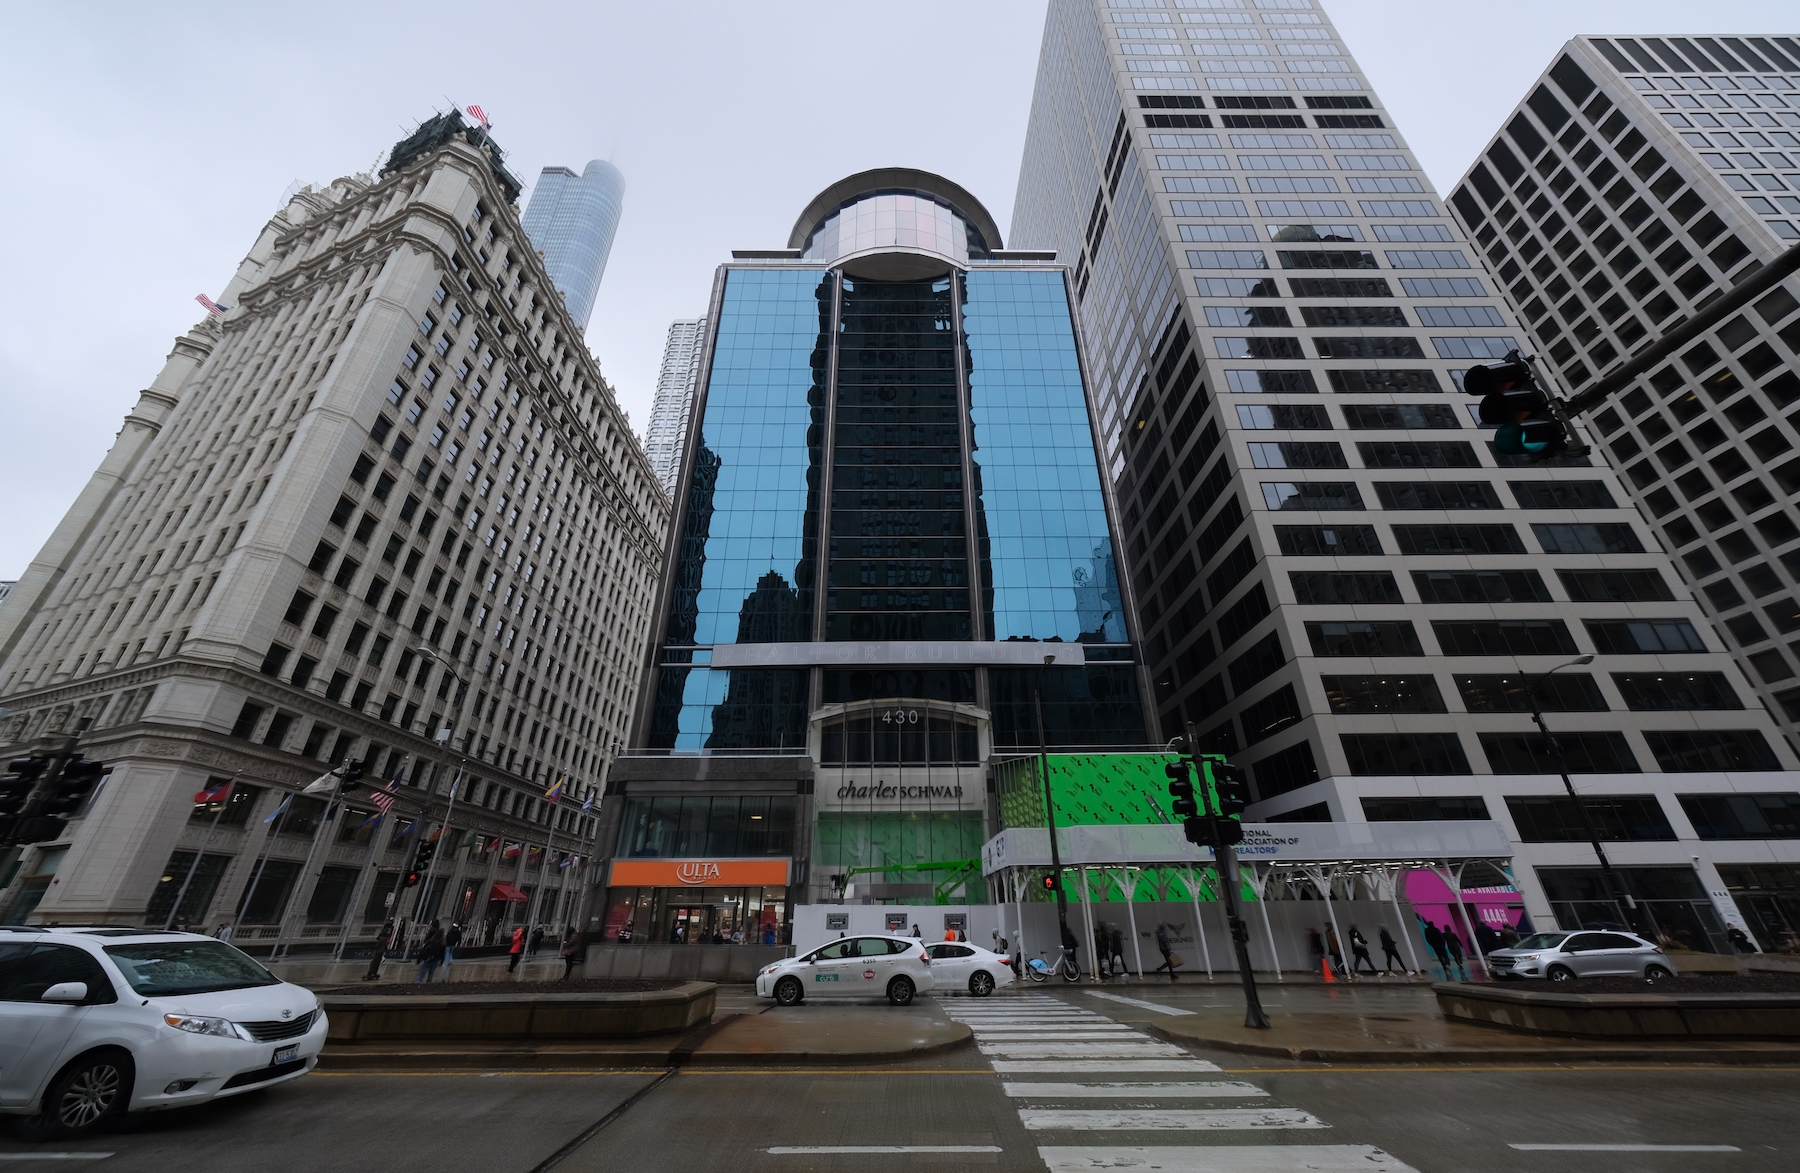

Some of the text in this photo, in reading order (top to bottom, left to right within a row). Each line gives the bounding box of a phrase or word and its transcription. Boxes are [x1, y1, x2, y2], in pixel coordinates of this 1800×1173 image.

[905, 645, 1074, 661] BUILDING
[882, 710, 918, 724] 430
[837, 780, 963, 799] charles SCHWAB
[1237, 837, 1299, 846] SSOCIATION OF
[683, 863, 720, 877] ULTA
[1483, 908, 1502, 923] 444
